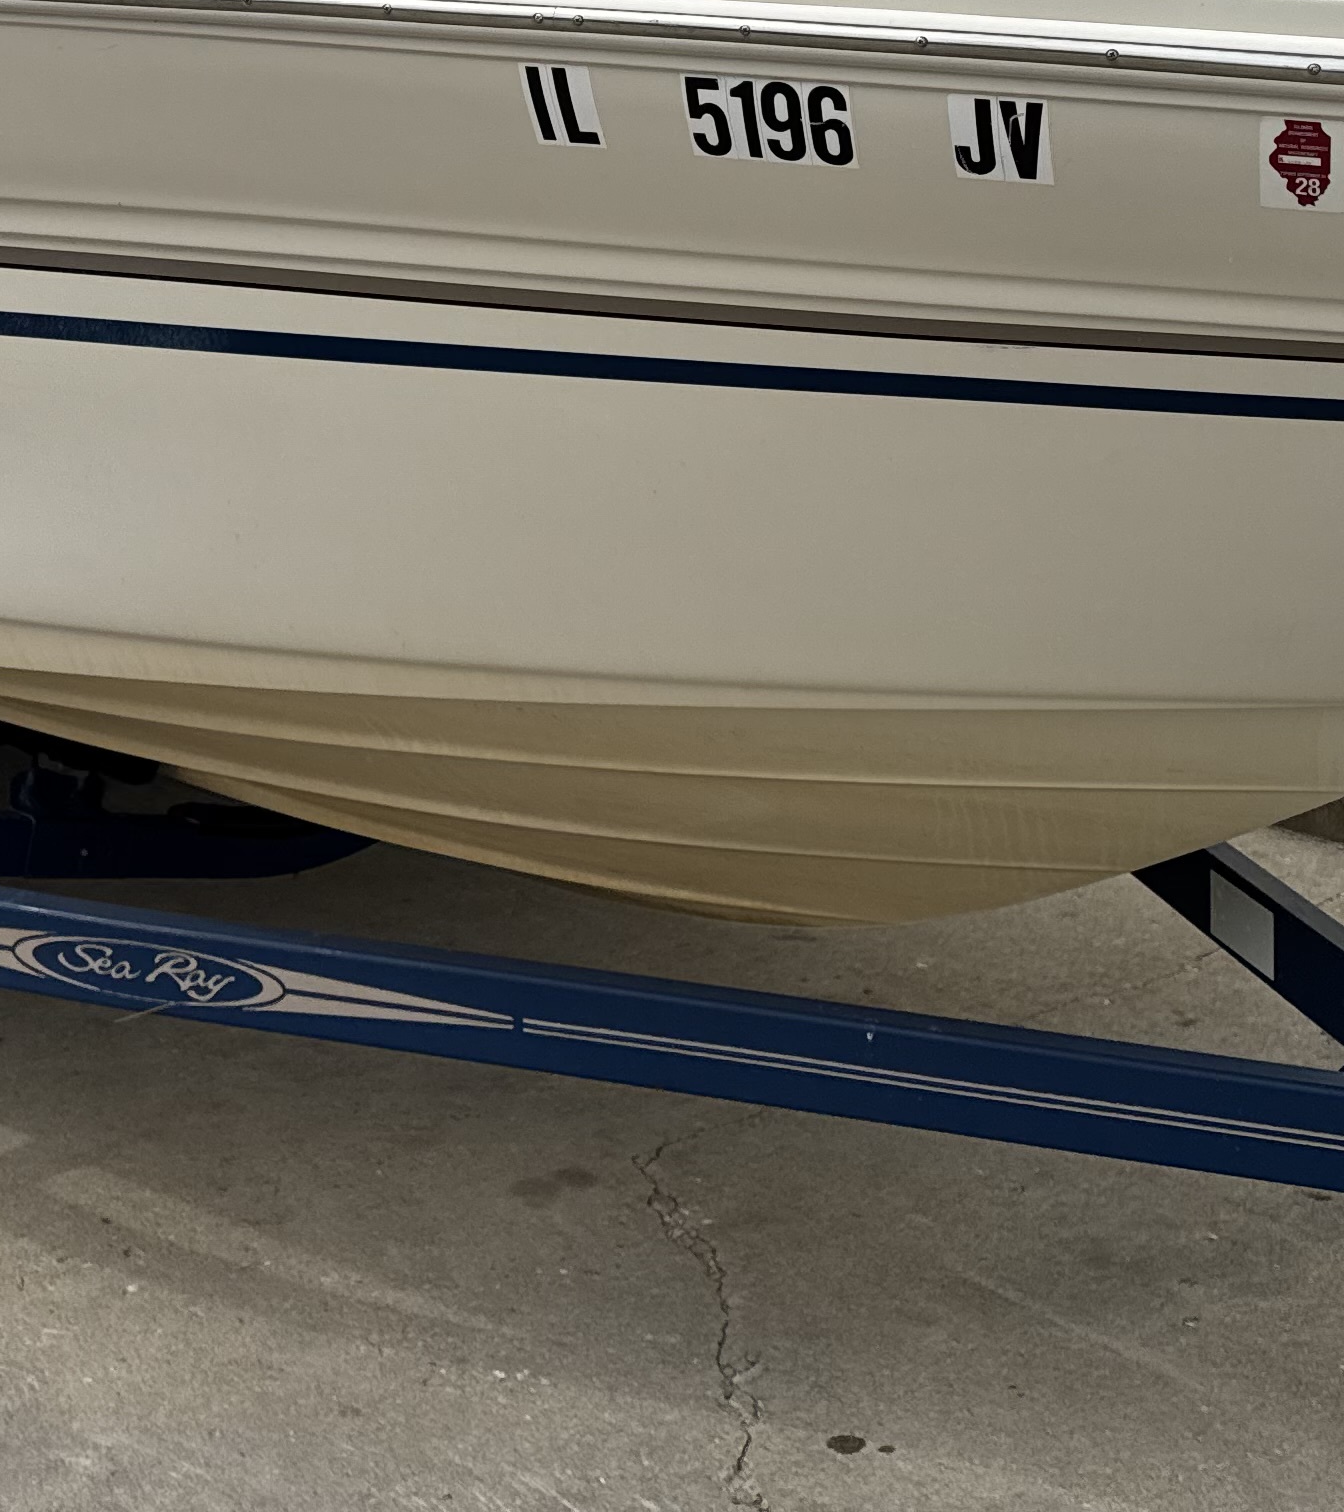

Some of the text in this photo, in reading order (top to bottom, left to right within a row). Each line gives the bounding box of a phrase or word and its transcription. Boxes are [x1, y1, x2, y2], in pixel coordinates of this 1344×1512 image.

[524, 65, 1044, 180] IL 5196 JV
[1295, 177, 1321, 197] 28
[57, 943, 235, 1002] Sea Ray
